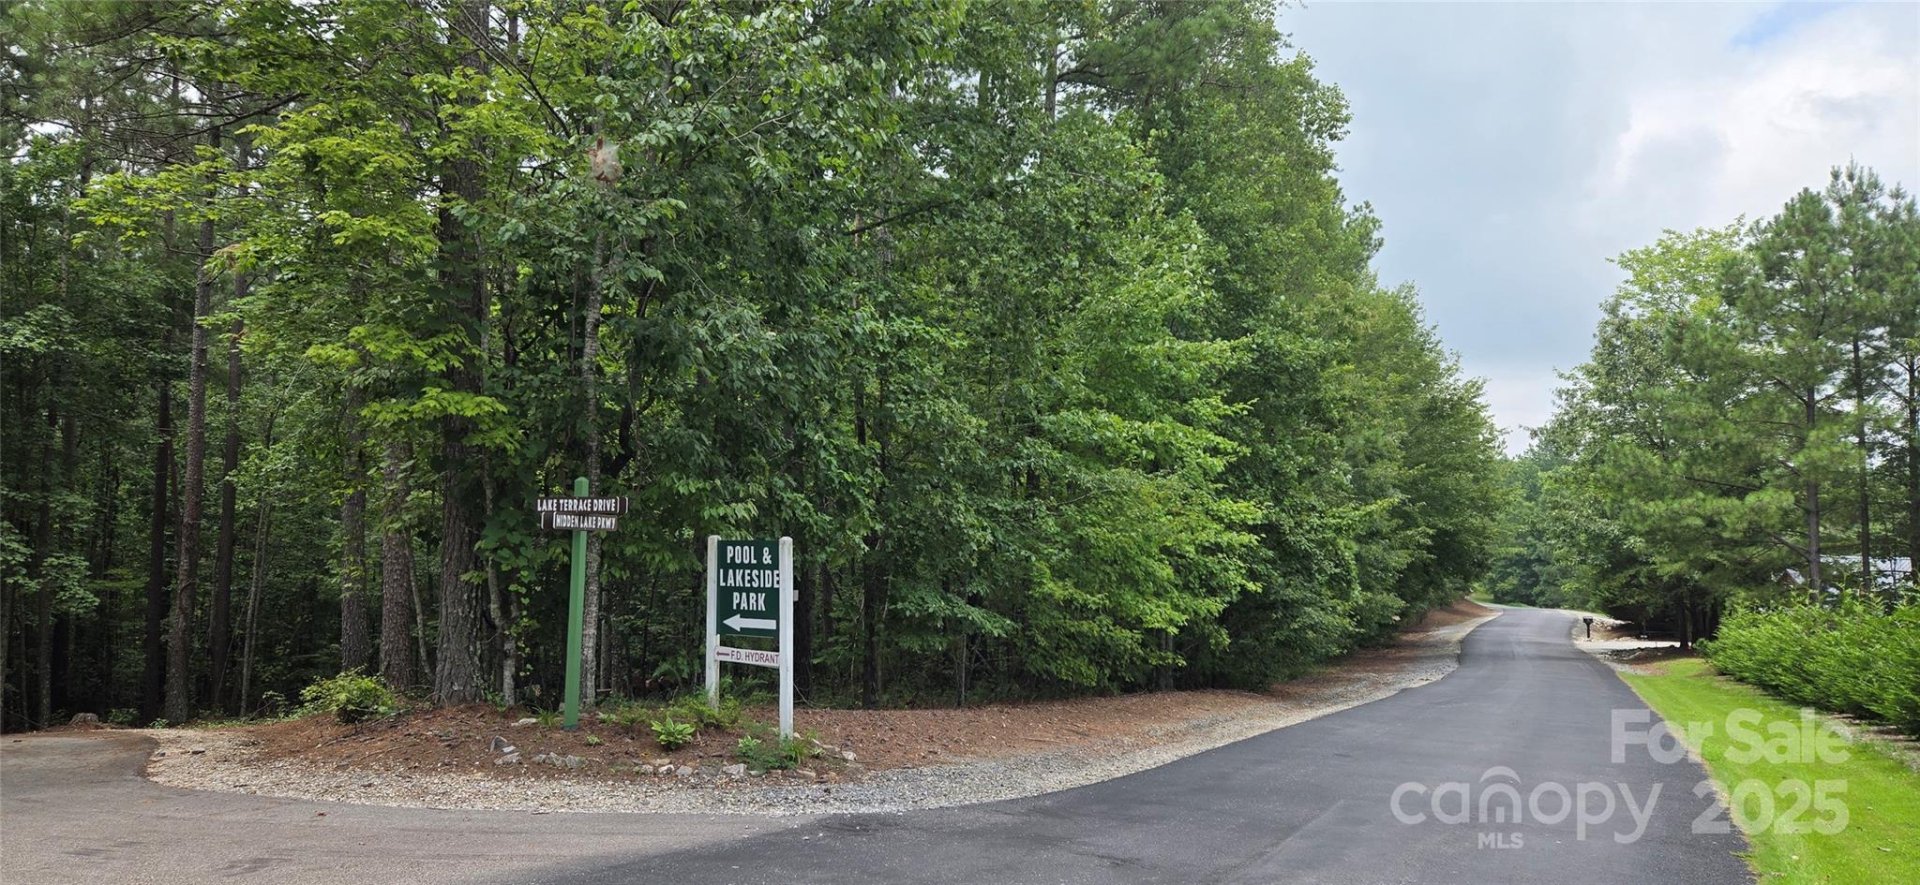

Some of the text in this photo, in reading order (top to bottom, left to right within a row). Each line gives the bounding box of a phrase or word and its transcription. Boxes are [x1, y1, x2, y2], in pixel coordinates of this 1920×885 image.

[537, 499, 616, 511] LAKE TERRACE DRIVE
[556, 514, 616, 529] HIDDEN LAKE PKWY
[726, 545, 772, 565] POOL &
[719, 568, 780, 588] LAKESIDE
[732, 592, 766, 611] PARK
[745, 652, 779, 664] HYDRANT
